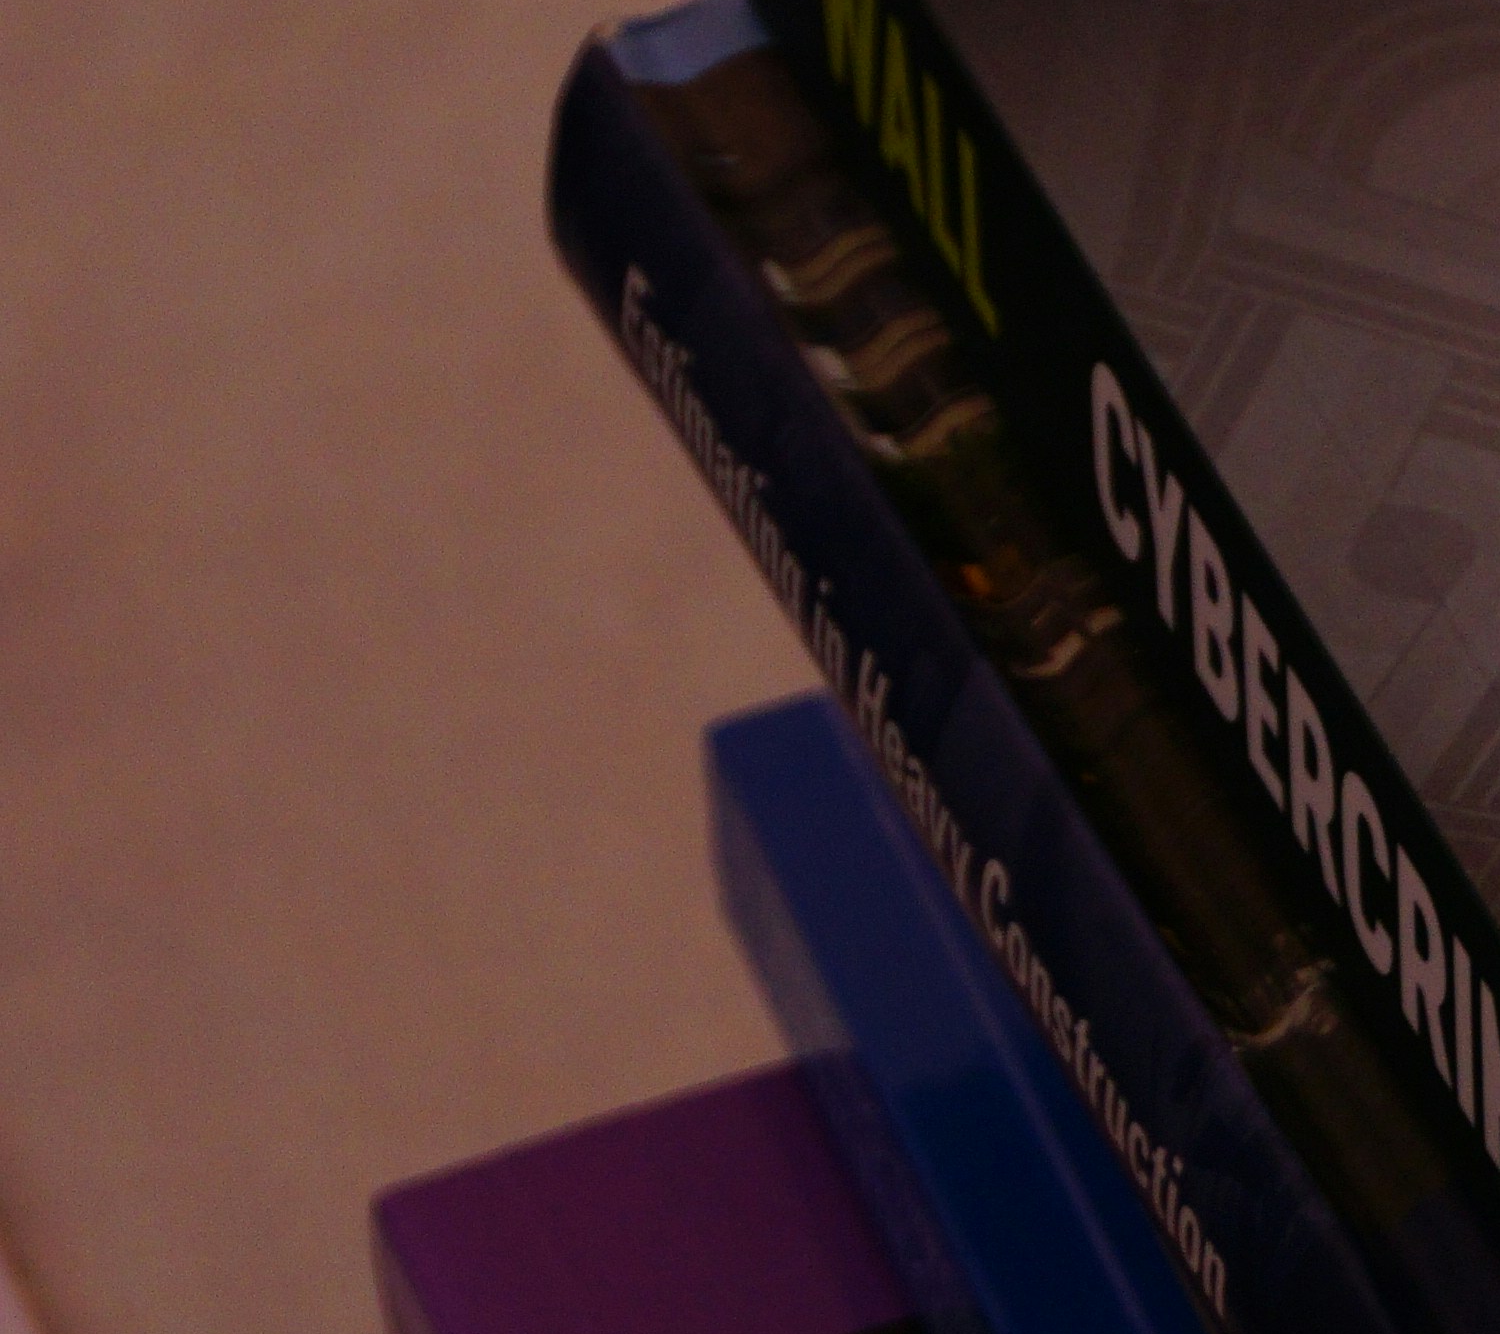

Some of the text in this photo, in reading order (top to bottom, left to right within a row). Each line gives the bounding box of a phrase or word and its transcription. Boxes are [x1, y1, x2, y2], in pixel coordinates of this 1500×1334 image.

[620, 260, 1230, 1318] Estimating in Heavy Construction
